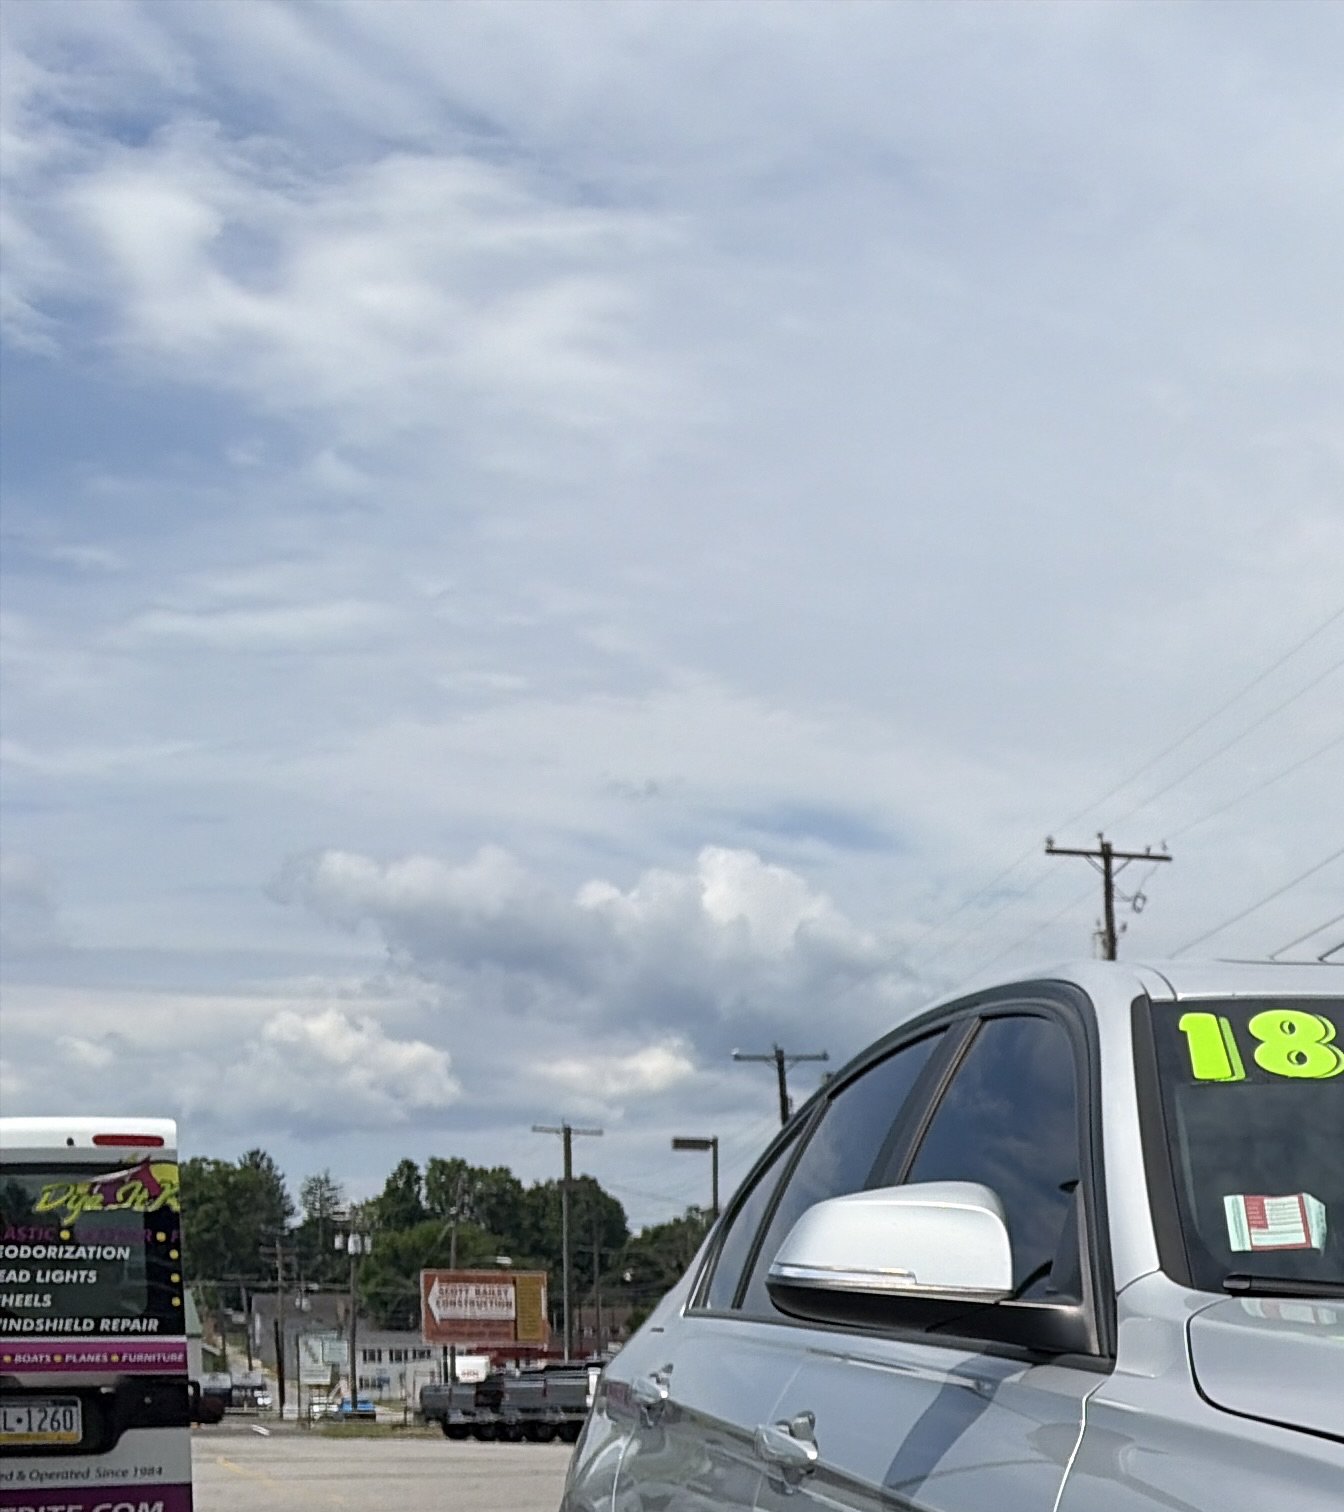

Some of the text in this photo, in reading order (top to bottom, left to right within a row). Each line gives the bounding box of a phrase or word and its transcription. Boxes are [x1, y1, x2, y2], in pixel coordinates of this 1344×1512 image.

[35, 1269, 98, 1284] LIGHTS
[99, 1318, 160, 1332] REPAIR
[14, 1352, 185, 1364] BOATS PLANES FURNITURE
[29, 1467, 91, 1483] Operated
[95, 1466, 129, 1480] Since
